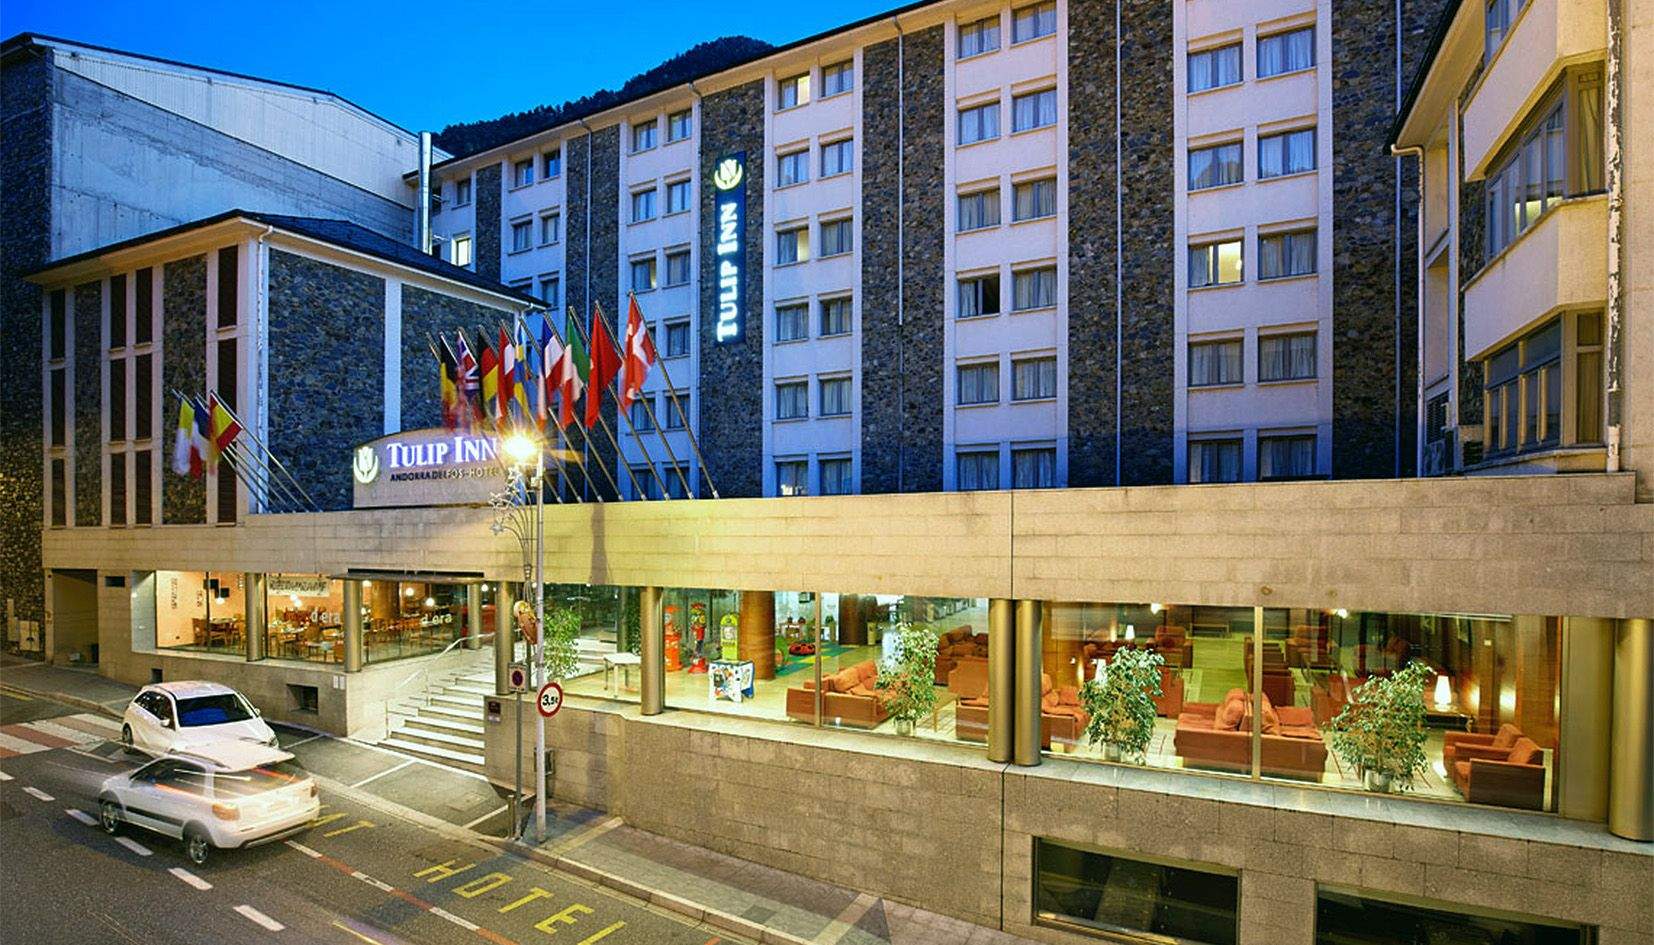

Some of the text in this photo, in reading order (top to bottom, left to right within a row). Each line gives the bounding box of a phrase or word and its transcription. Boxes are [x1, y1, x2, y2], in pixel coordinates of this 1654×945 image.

[716, 202, 738, 343] TULIP INN
[386, 436, 498, 469] TULIP INN
